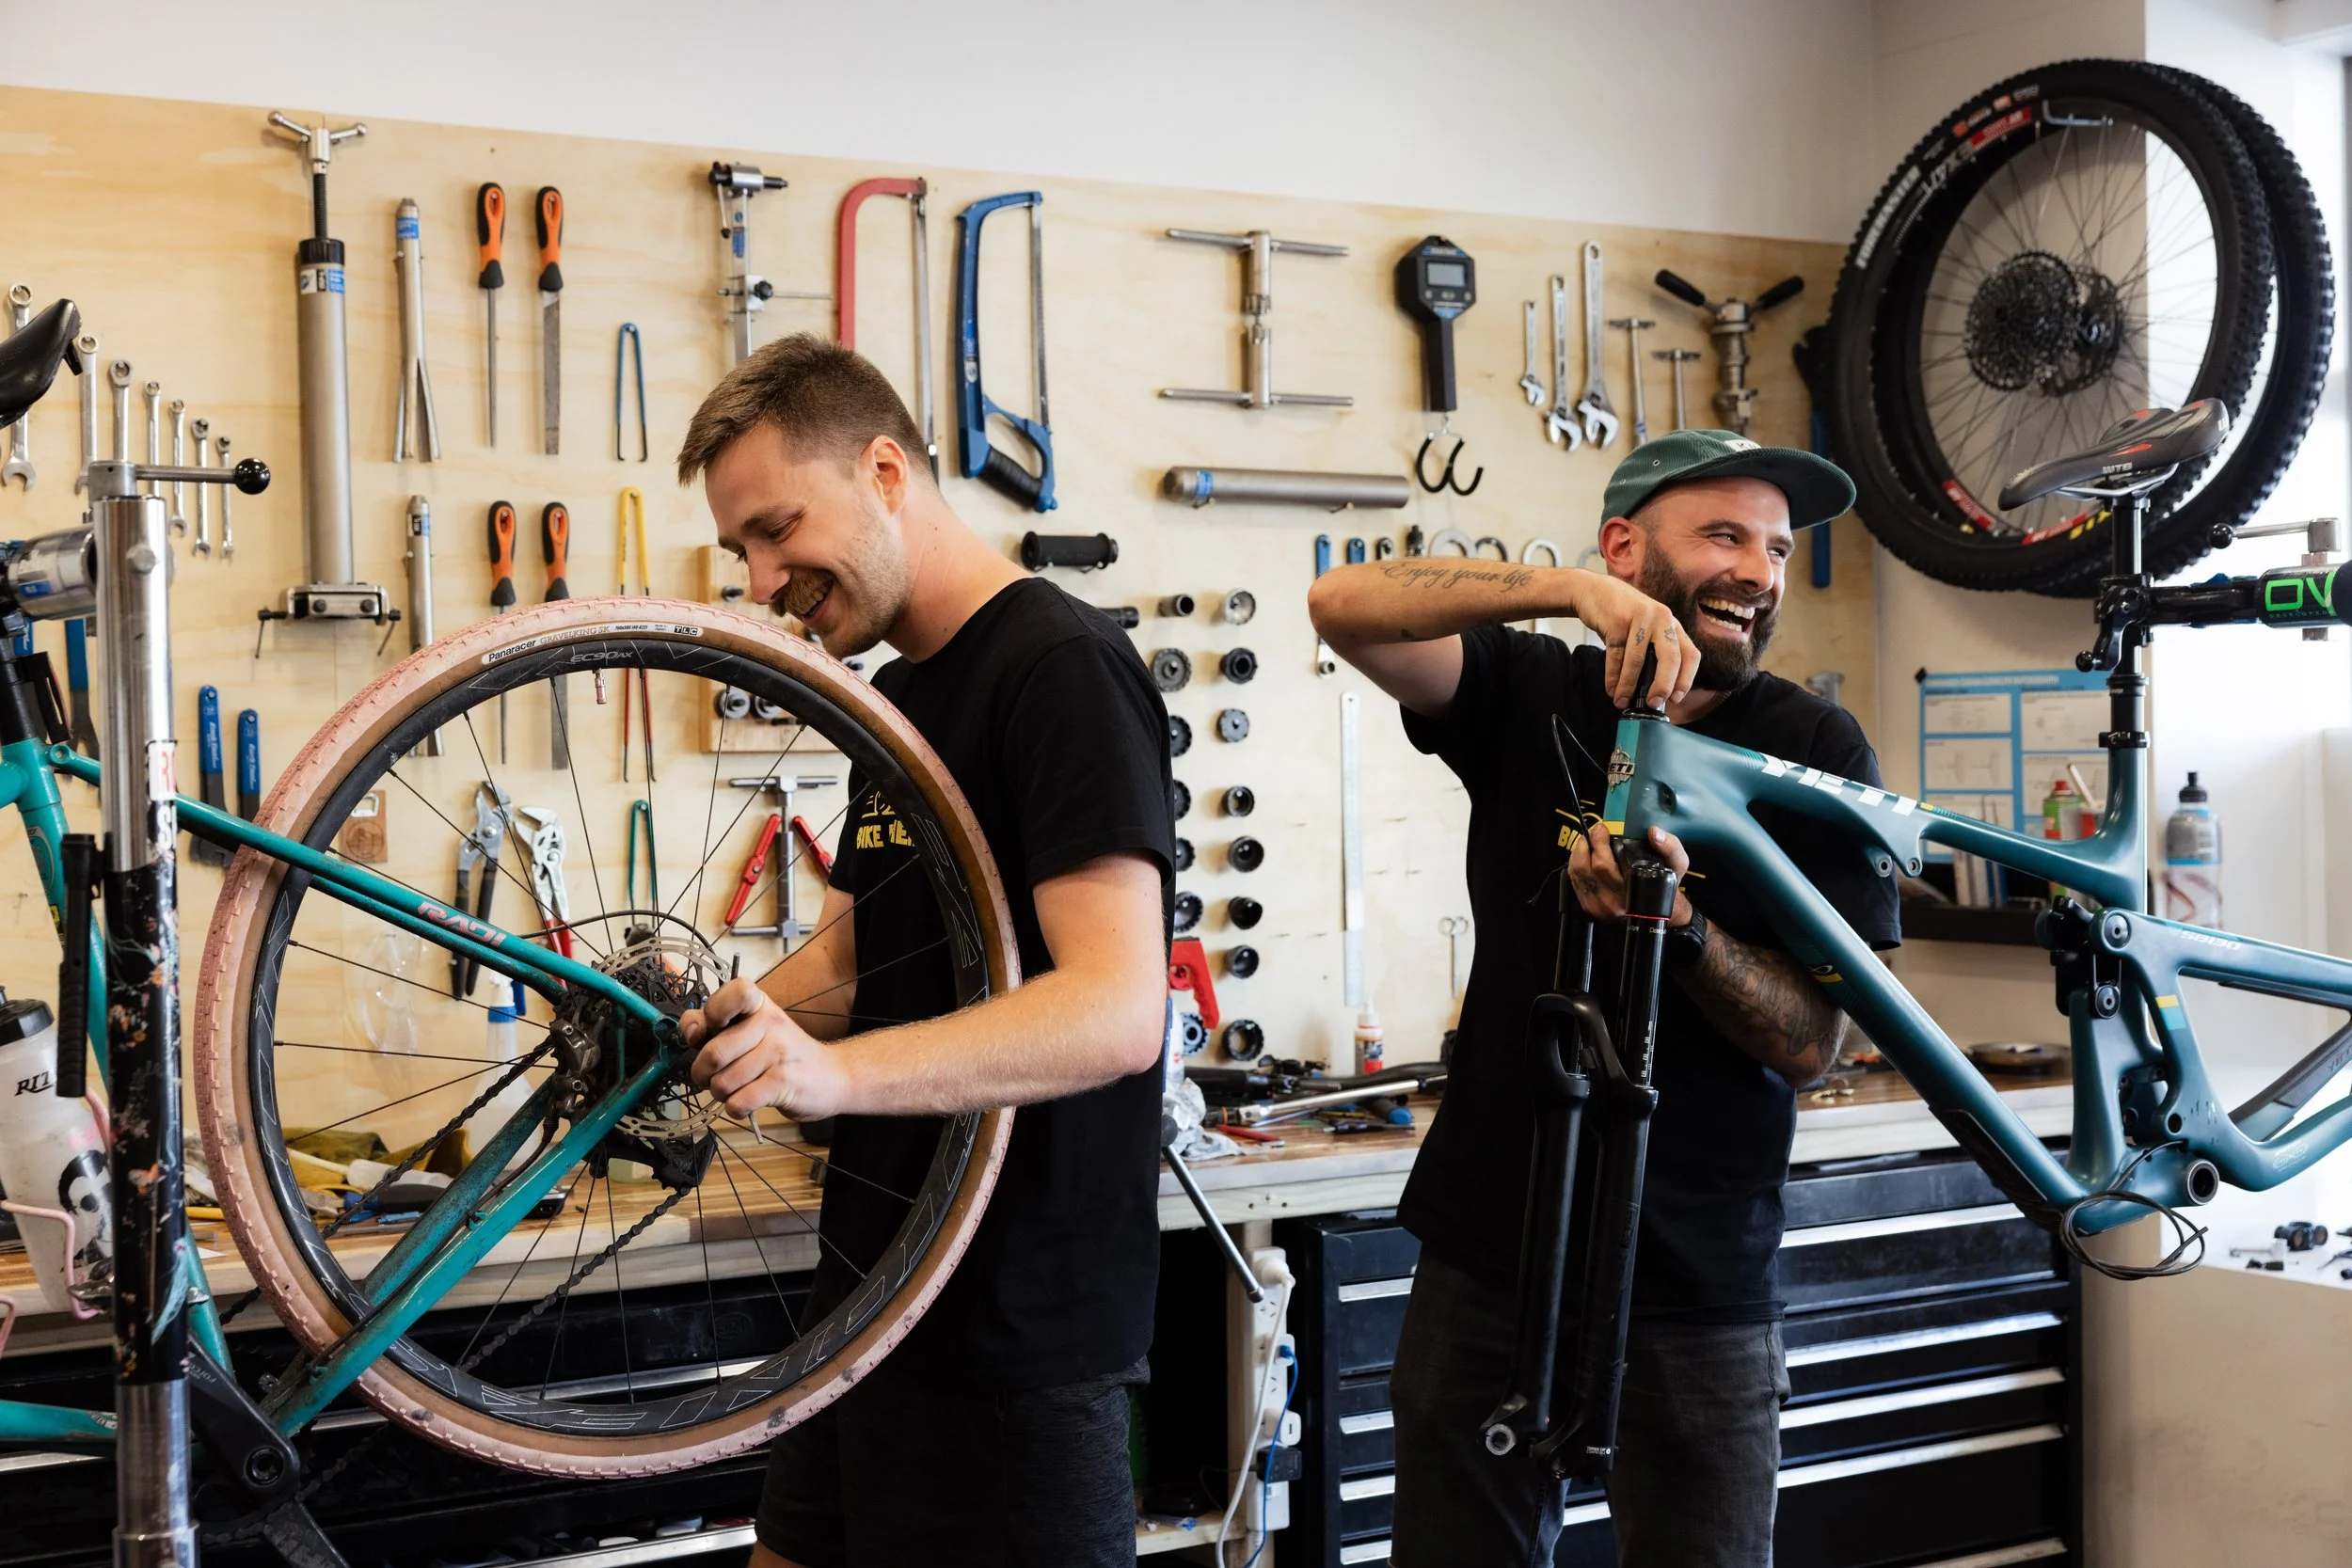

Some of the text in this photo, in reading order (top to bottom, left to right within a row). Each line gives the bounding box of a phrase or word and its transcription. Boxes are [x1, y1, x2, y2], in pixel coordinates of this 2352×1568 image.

[1380, 563, 1534, 593] Enjoy your life
[487, 639, 537, 662] Panaracer
[540, 626, 598, 644] GRAVELKING
[598, 626, 610, 634] SK
[674, 625, 699, 636] TLC
[856, 824, 884, 849] BIKE
